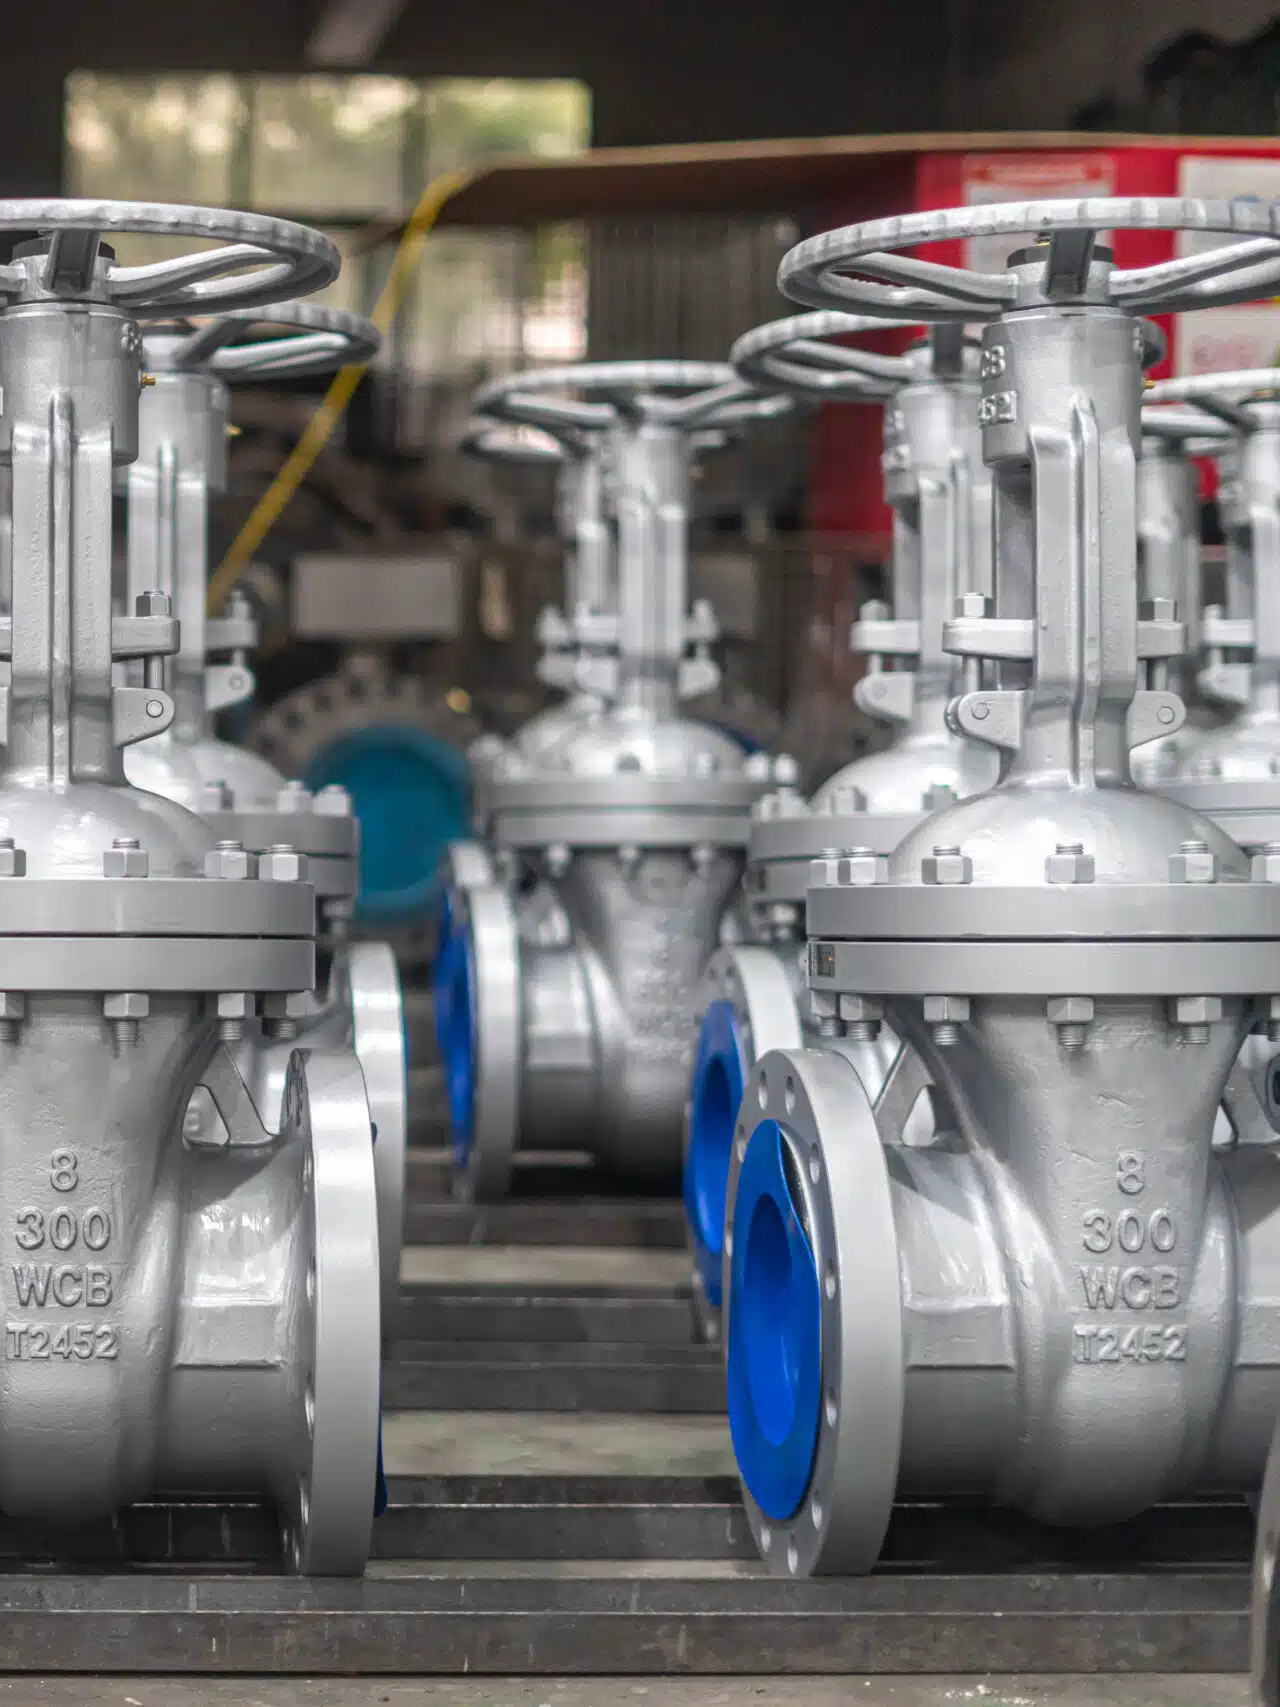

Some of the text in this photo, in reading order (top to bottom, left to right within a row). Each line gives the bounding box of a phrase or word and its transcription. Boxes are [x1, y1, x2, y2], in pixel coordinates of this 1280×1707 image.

[50, 1148, 78, 1192] 8
[1117, 1151, 1145, 1195] 8
[15, 1206, 111, 1250] 300
[1082, 1208, 1177, 1253] 300
[12, 1264, 113, 1307] WCB
[1079, 1266, 1182, 1310] WCB
[5, 1321, 120, 1361] T2452
[1073, 1325, 1187, 1363] T2452
